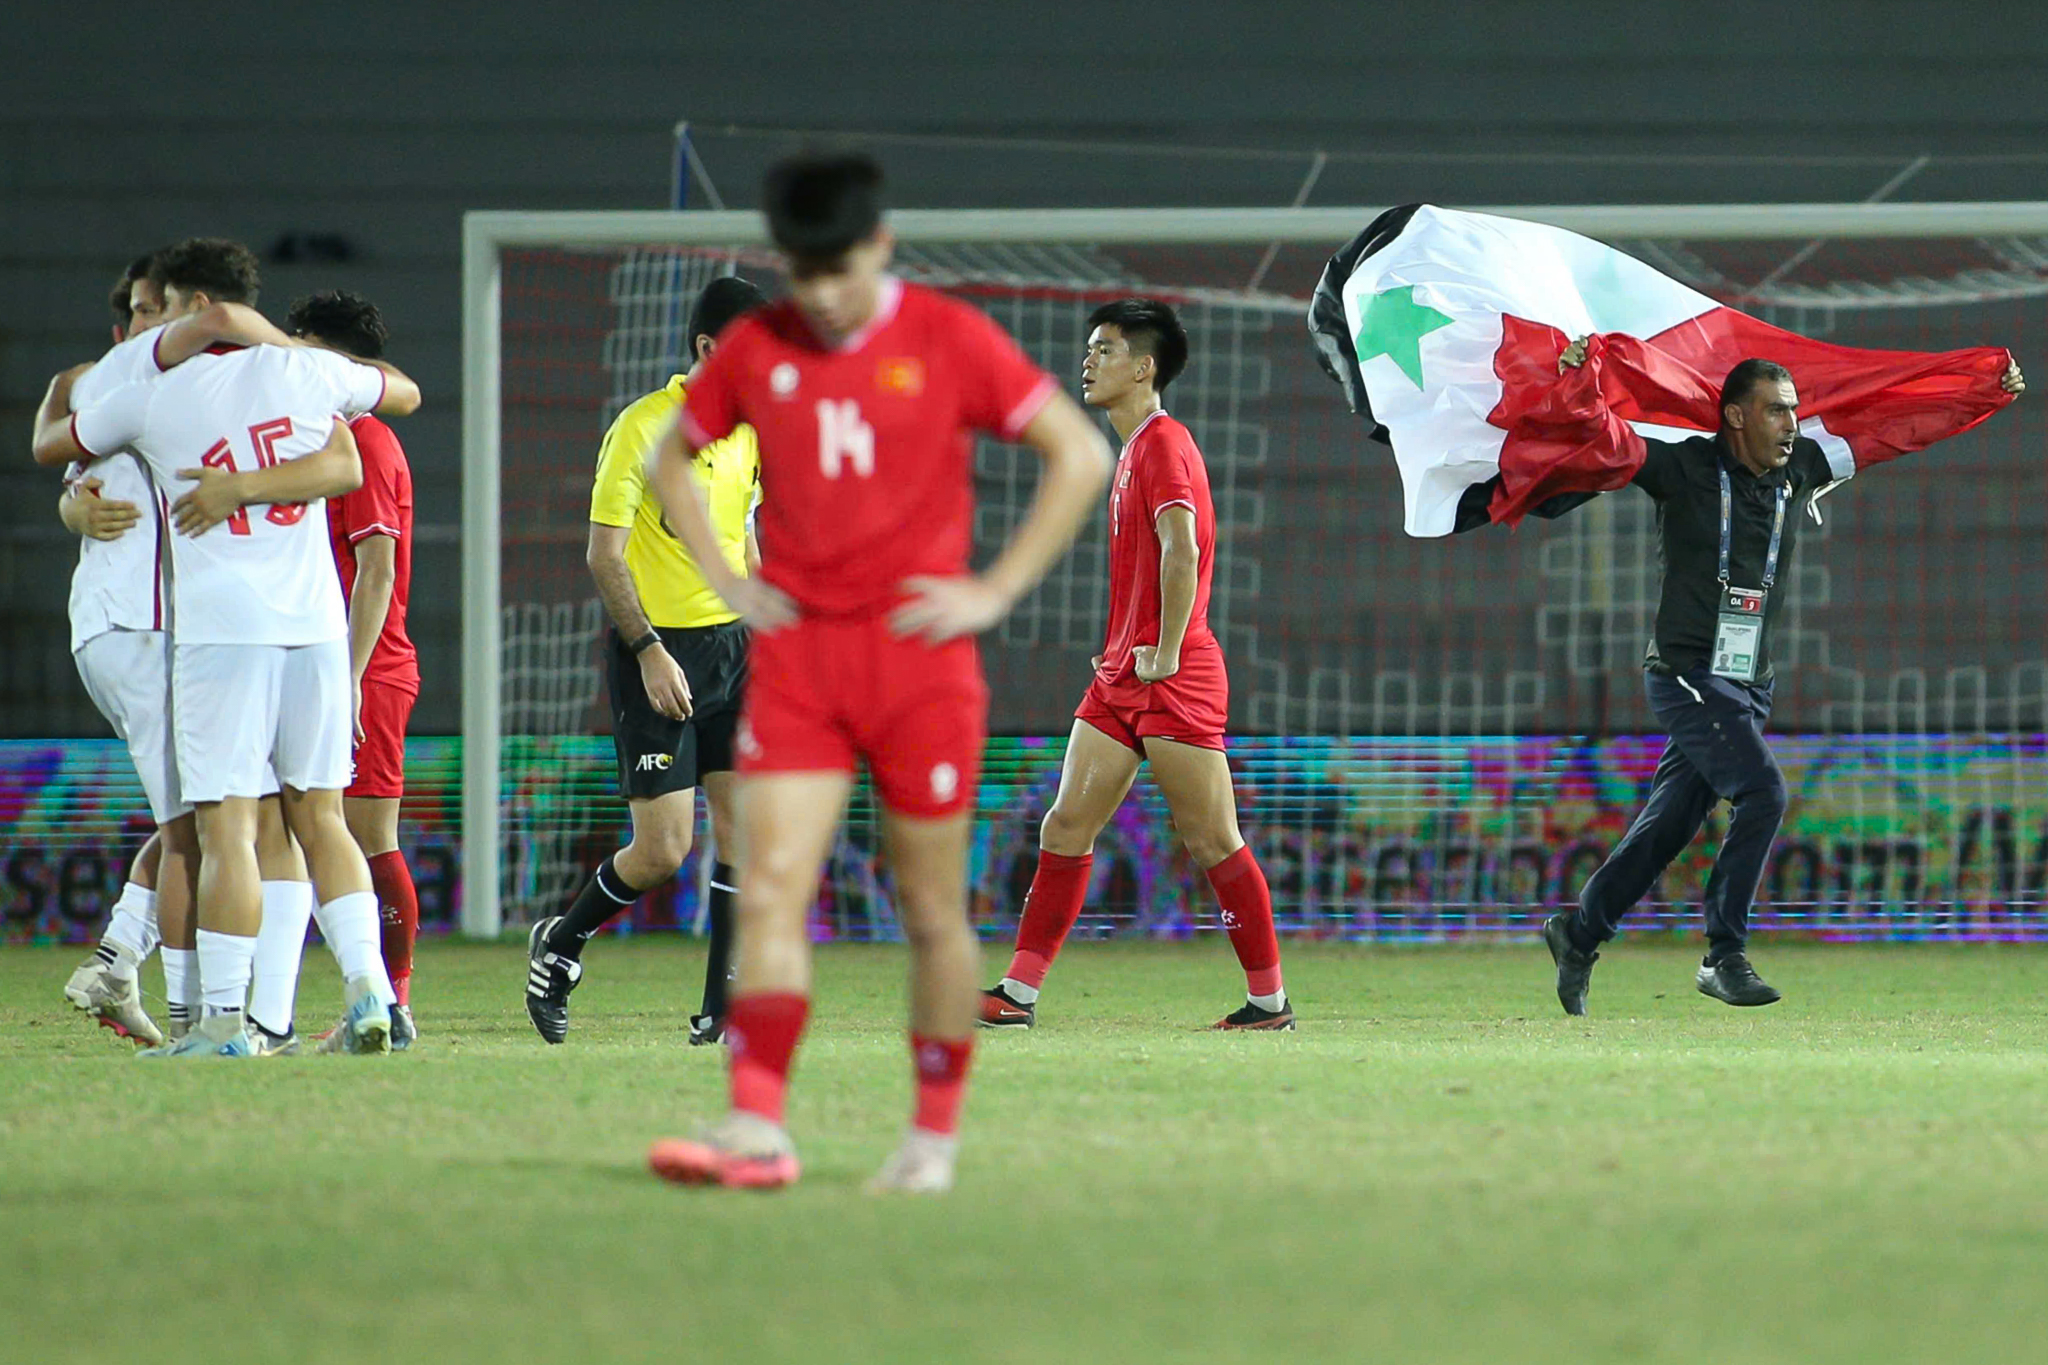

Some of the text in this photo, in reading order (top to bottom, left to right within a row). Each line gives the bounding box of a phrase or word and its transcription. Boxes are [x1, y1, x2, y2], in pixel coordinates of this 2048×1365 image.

[200, 416, 308, 536] 15
[816, 398, 876, 479] 14
[635, 753, 671, 771] AFC
